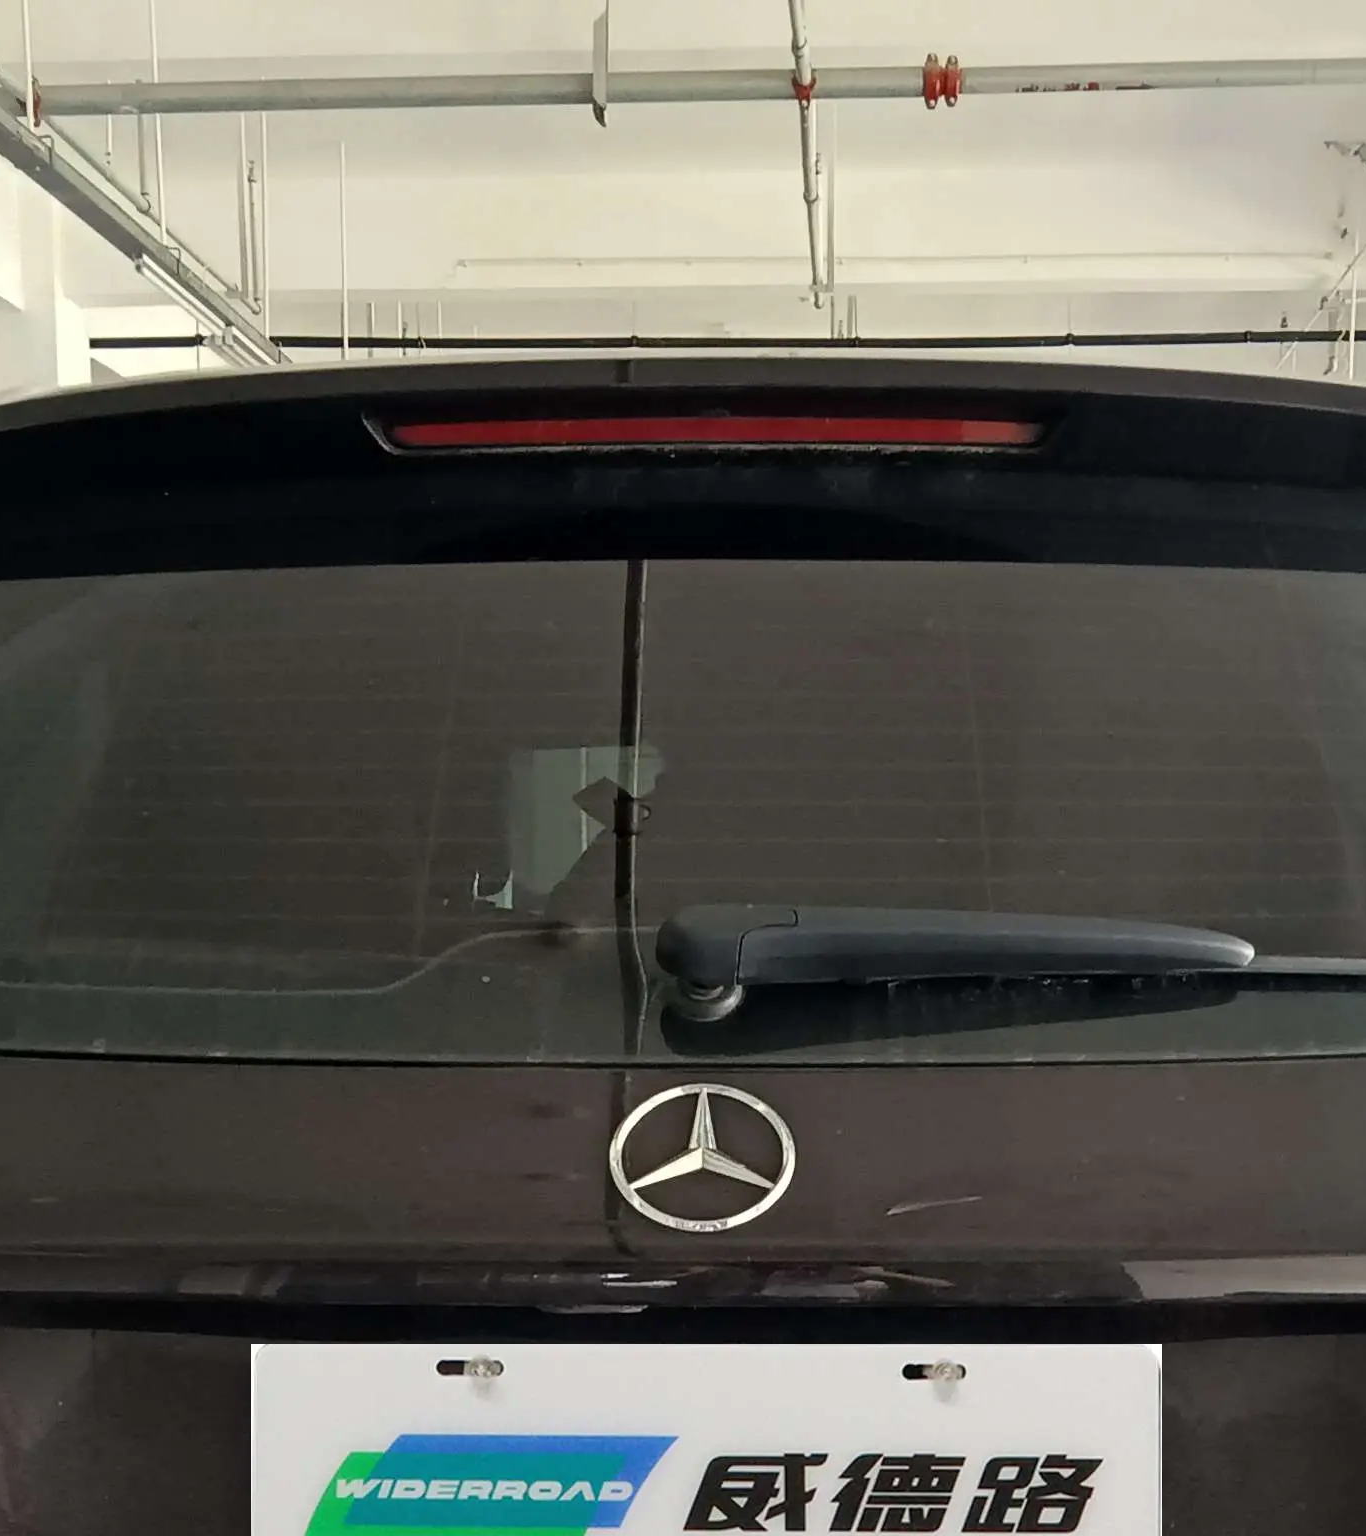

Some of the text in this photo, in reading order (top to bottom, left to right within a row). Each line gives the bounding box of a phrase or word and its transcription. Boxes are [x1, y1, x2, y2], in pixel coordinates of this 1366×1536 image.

[333, 1477, 635, 1504] WIDERROAD
[682, 1453, 1103, 1534] 威德路
